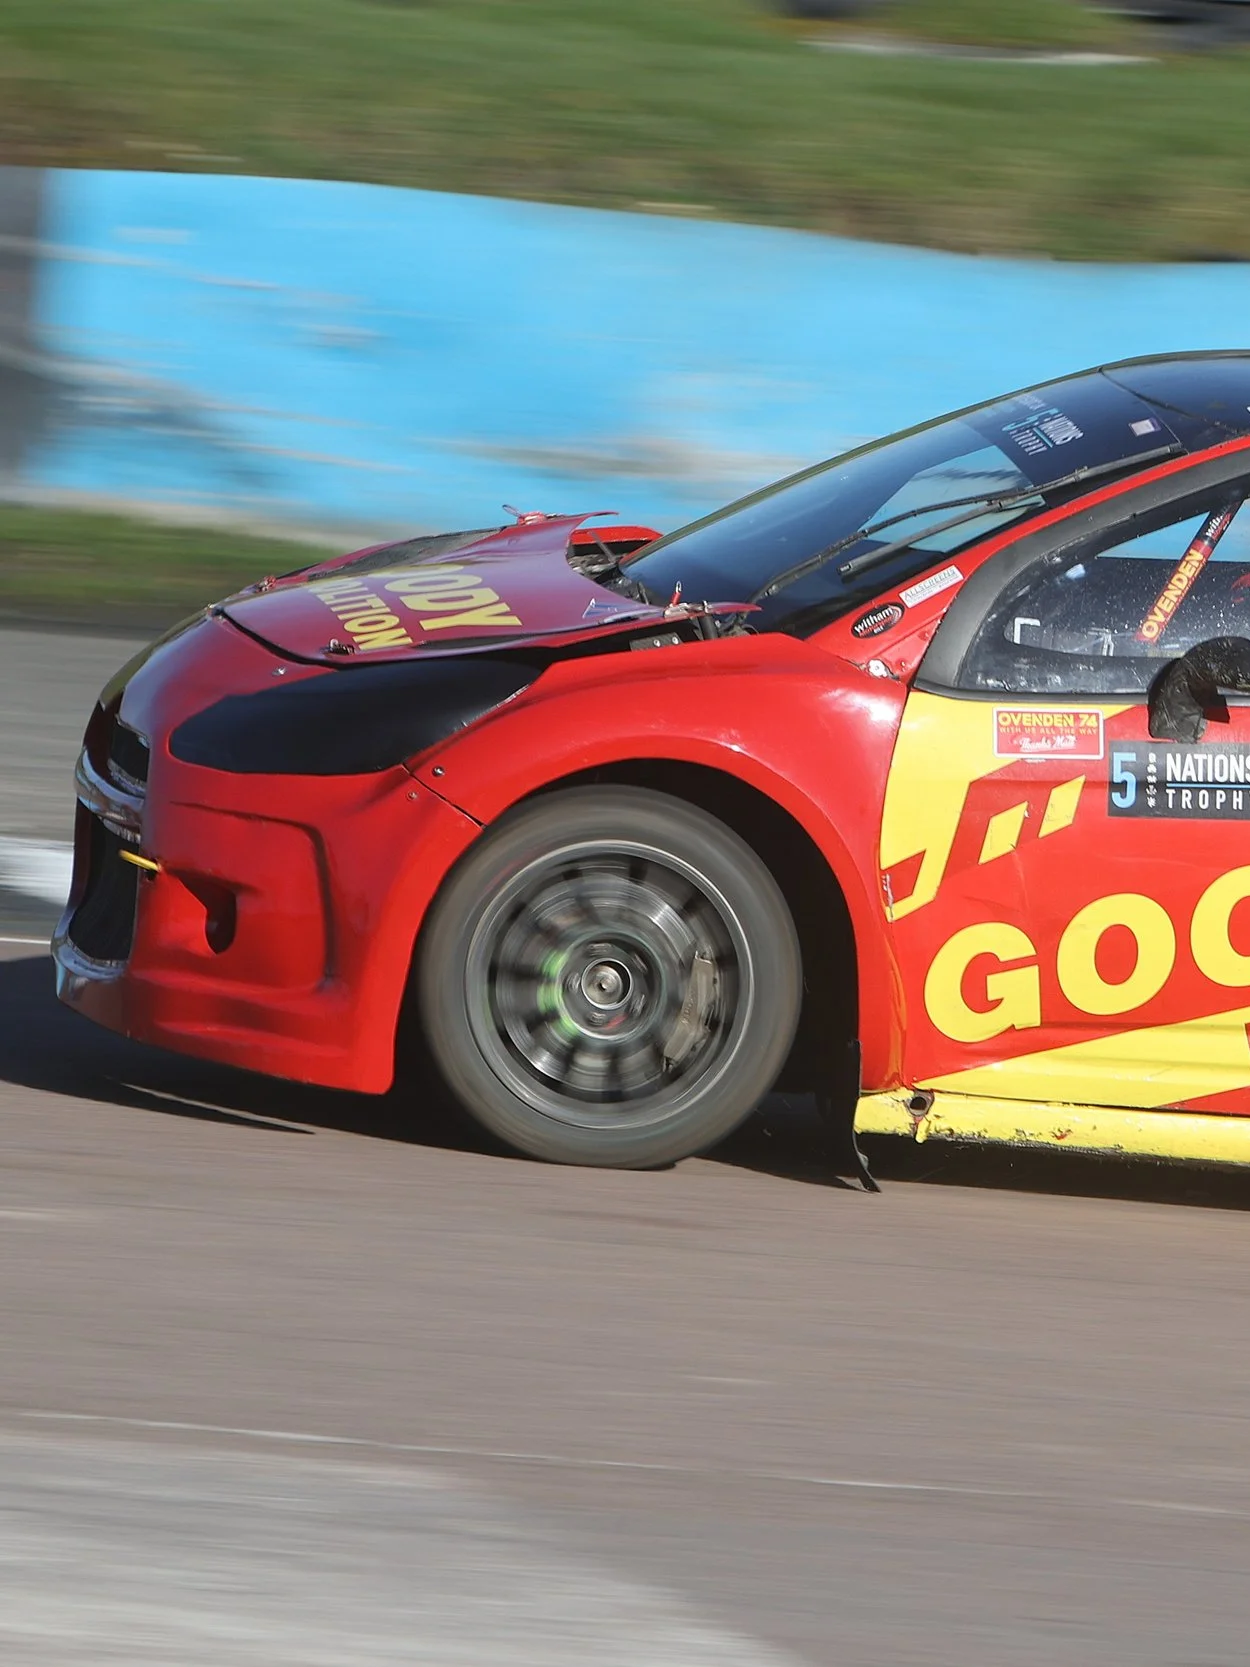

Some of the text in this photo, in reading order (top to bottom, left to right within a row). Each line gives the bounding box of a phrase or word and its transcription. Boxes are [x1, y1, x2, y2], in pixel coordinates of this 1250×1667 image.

[1142, 548, 1204, 638] OVENDEN
[854, 606, 894, 634] witham
[998, 712, 1098, 728] OVENDEN 74
[1112, 752, 1137, 808] 5
